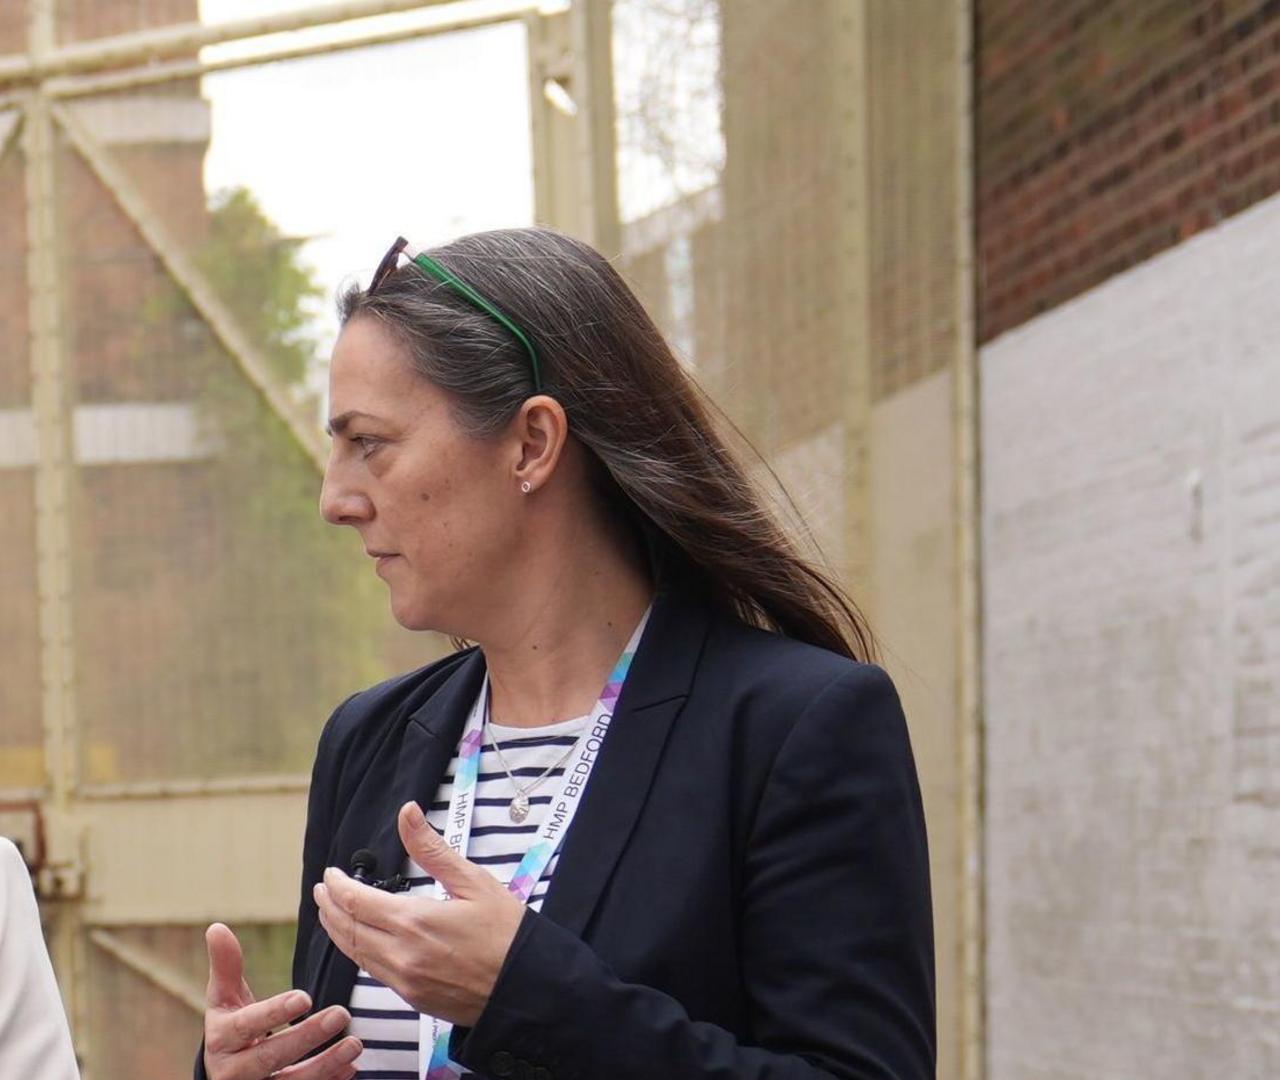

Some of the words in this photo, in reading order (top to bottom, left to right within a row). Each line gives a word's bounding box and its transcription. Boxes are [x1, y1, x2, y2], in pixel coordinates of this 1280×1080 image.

[453, 793, 469, 829] HMP
[543, 801, 568, 839] HMP
[564, 714, 613, 798] BEDFORD
